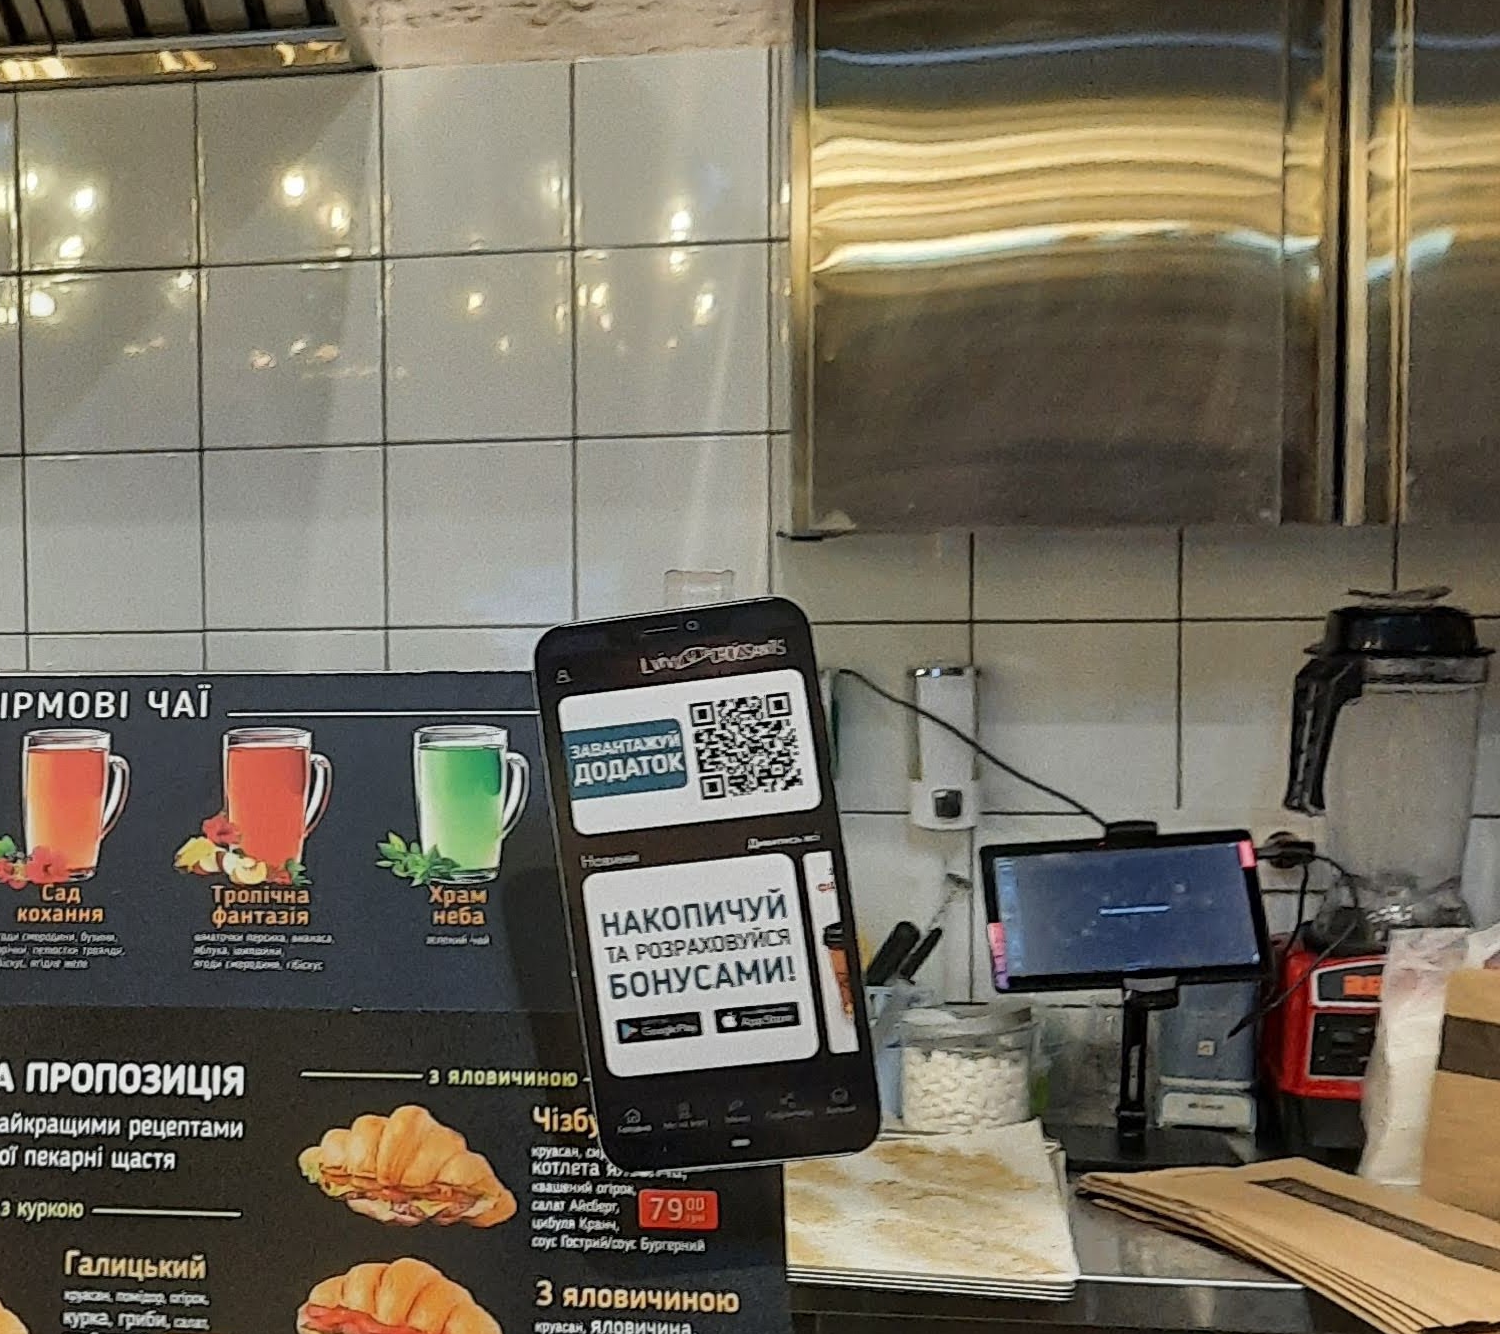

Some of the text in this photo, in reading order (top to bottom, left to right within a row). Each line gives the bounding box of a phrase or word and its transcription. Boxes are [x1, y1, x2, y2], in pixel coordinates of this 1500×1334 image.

[148, 682, 212, 722] ЧАЇ
[570, 730, 681, 759] ЗАВАНТАЖУЙ
[573, 753, 684, 786] ДОДАТОК
[41, 882, 82, 904] Сад
[212, 884, 310, 910] Тропічна
[429, 884, 487, 910] Храм
[16, 902, 104, 926] кохання
[211, 904, 310, 929] фантазія
[432, 907, 485, 927] неба
[601, 888, 787, 938] НАКОПИЧУЙ
[605, 927, 791, 964] ТА РОЗРАХОВУЙСЯ
[608, 956, 797, 1000] БОНУСАМИ!
[25, 1063, 245, 1101] ПРОПОЗИЦІЯ
[448, 1069, 578, 1089] яловичиною
[129, 1119, 244, 1141] рецептами
[24, 1149, 103, 1172] пекарні
[111, 1151, 175, 1171] щастя
[17, 1200, 84, 1222] куркою
[64, 1249, 206, 1281] Галицький
[563, 1286, 740, 1315] яловичиною
